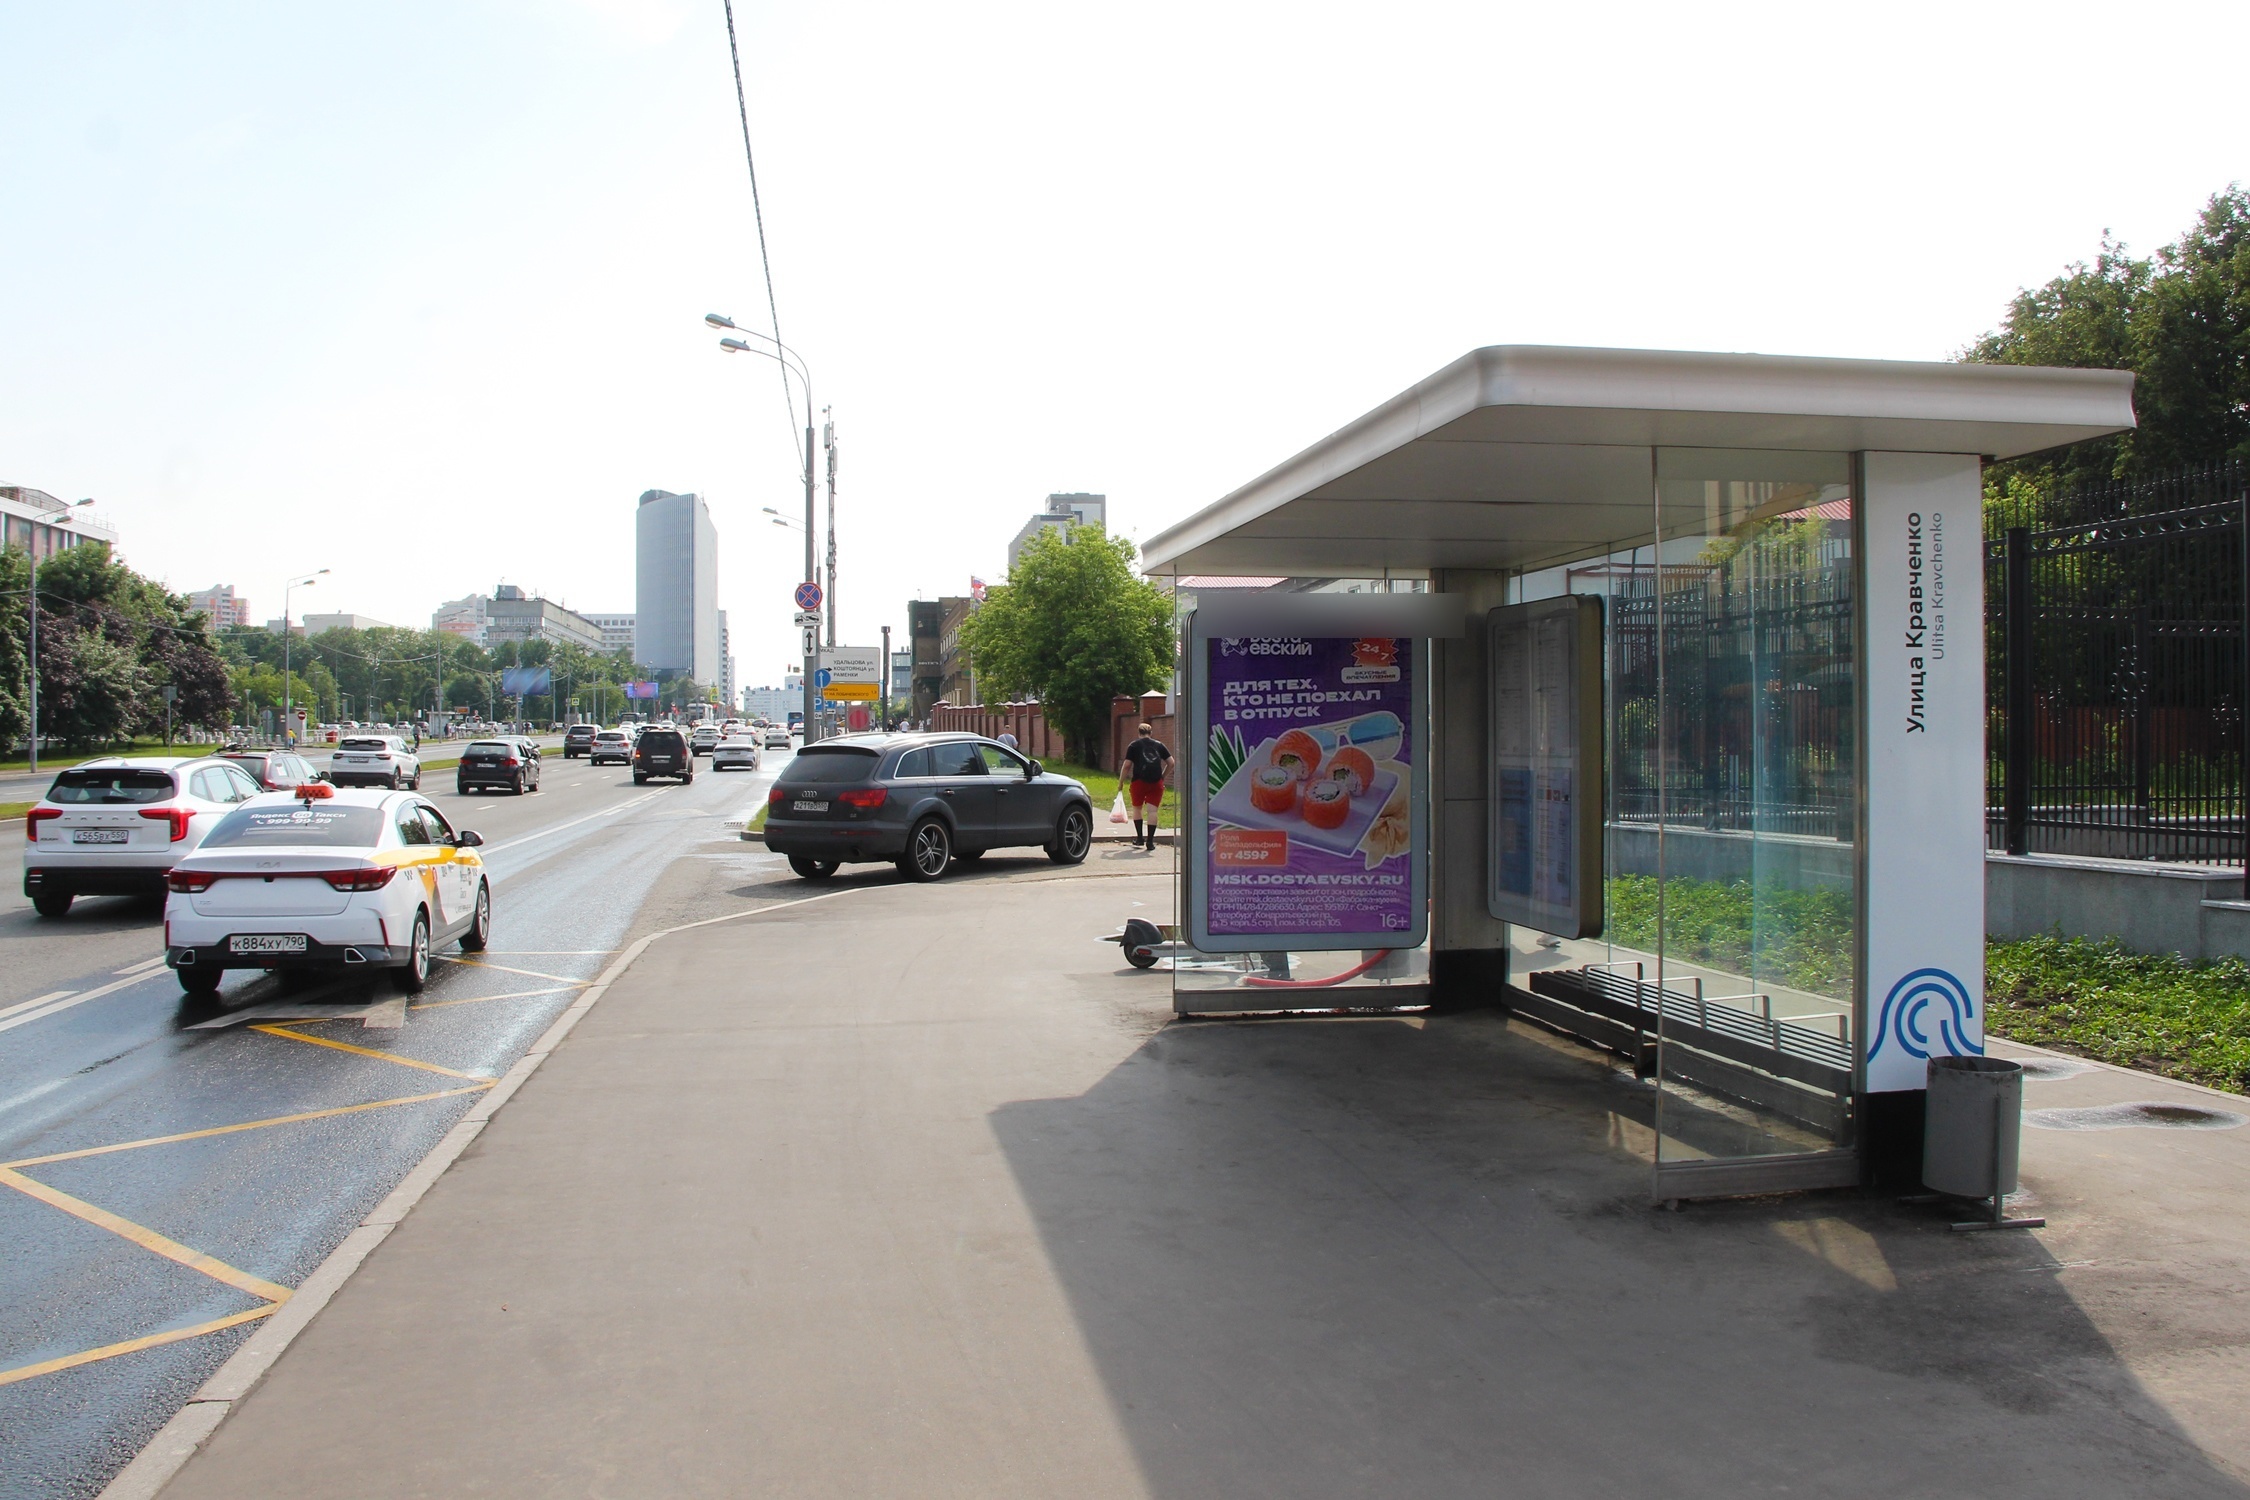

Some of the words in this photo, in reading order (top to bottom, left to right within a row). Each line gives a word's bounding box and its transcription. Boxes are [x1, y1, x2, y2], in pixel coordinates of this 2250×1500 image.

[1929, 512, 1944, 609] Kravchenko
[1906, 512, 1927, 648] Кравченко
[1931, 615, 1944, 660] Ulitsa
[1361, 643, 1379, 654] 24
[1380, 652, 1389, 661] 7
[1223, 680, 1272, 695] ДЛЯ
[1273, 678, 1318, 692] ТЕХ,
[1224, 694, 1264, 707] КТО
[1266, 693, 1294, 705] НЕ
[1296, 690, 1382, 704] ПОЕХАЛ
[1906, 656, 1927, 733] Улица
[1224, 709, 1239, 721] В
[1240, 706, 1321, 720] ОТПУСК
[1220, 852, 1233, 860] от
[1214, 874, 1404, 885] MSK.DOSTAEVSKY.RU
[1379, 913, 1408, 928] 16+
[285, 936, 303, 946] 790
